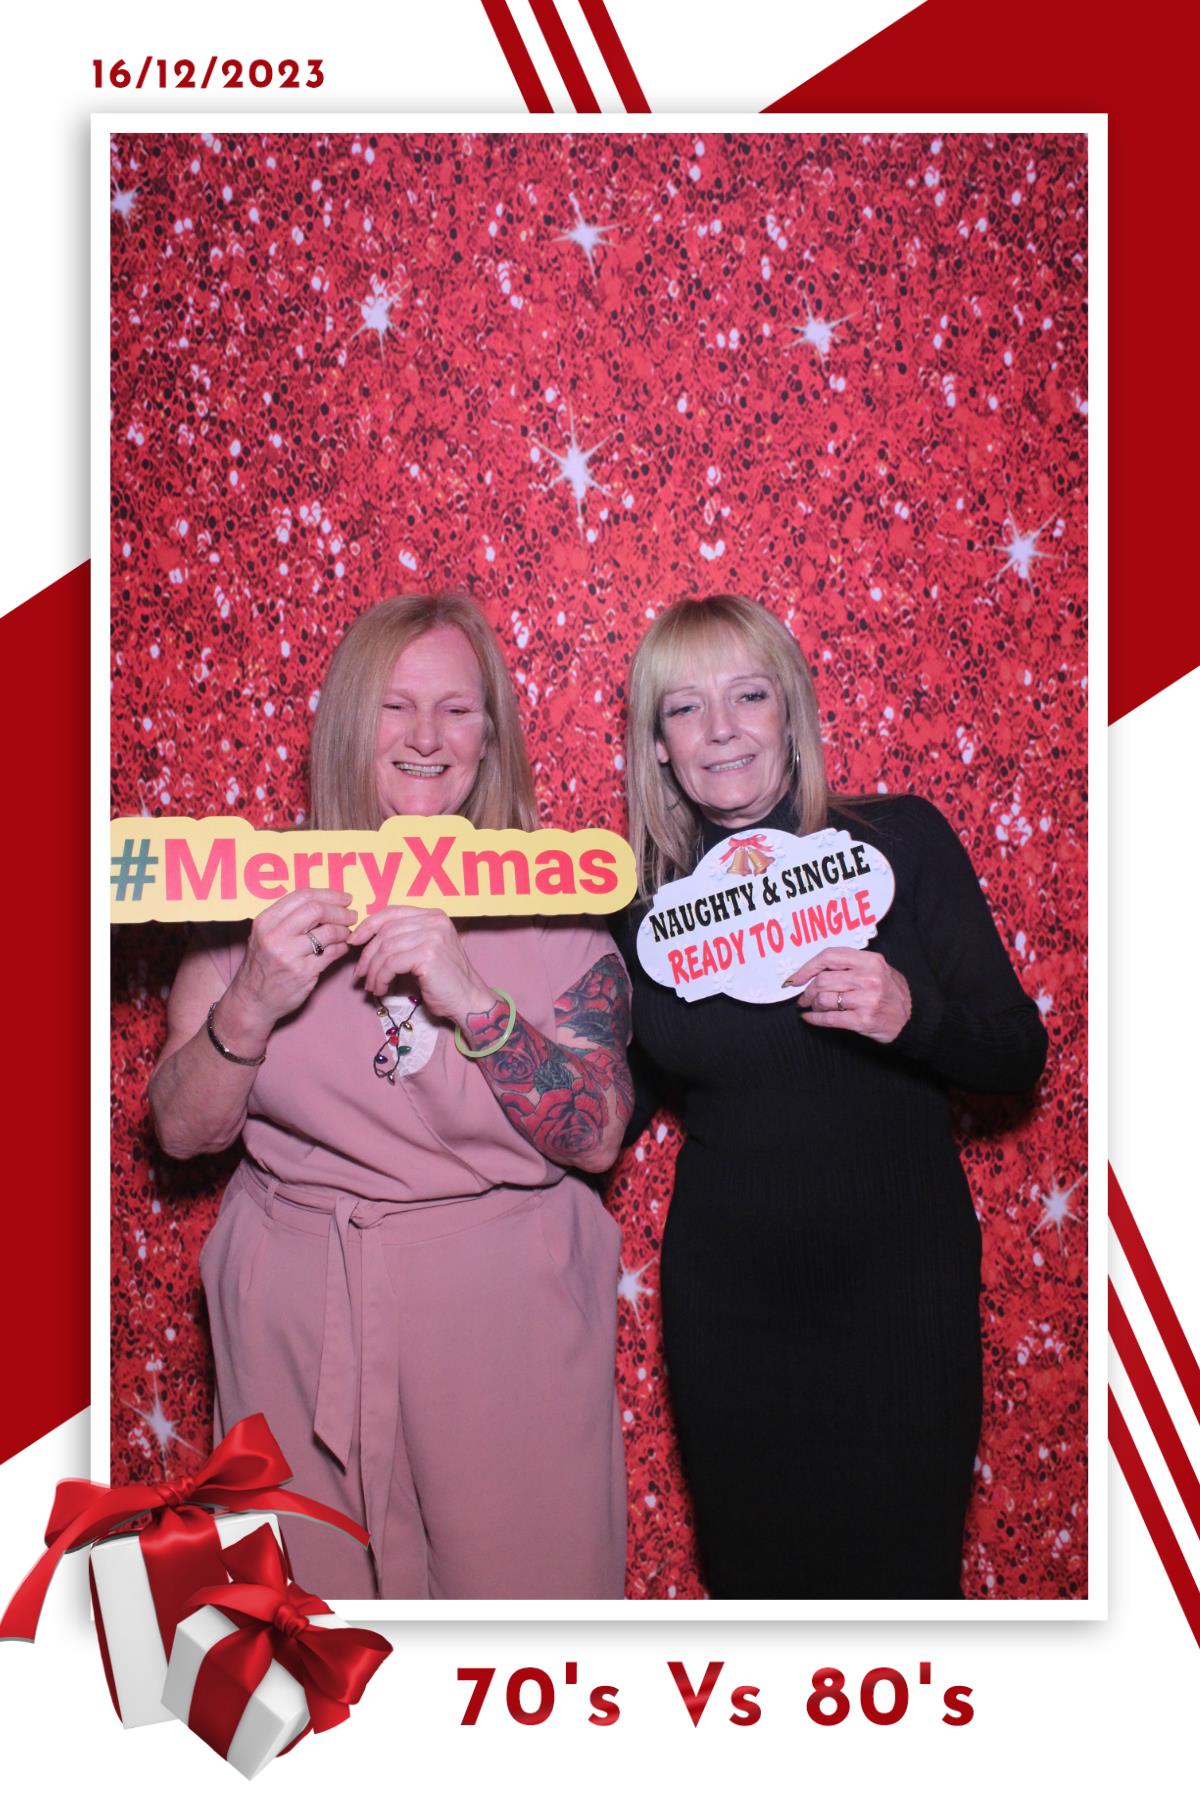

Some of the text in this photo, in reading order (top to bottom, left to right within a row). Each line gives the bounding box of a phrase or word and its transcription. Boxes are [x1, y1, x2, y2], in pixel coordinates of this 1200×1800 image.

[110, 836, 619, 916] #MerryXmas
[649, 845, 871, 943] NAUGHTY & SINGLE
[667, 889, 877, 985] READY TO JINGLE
